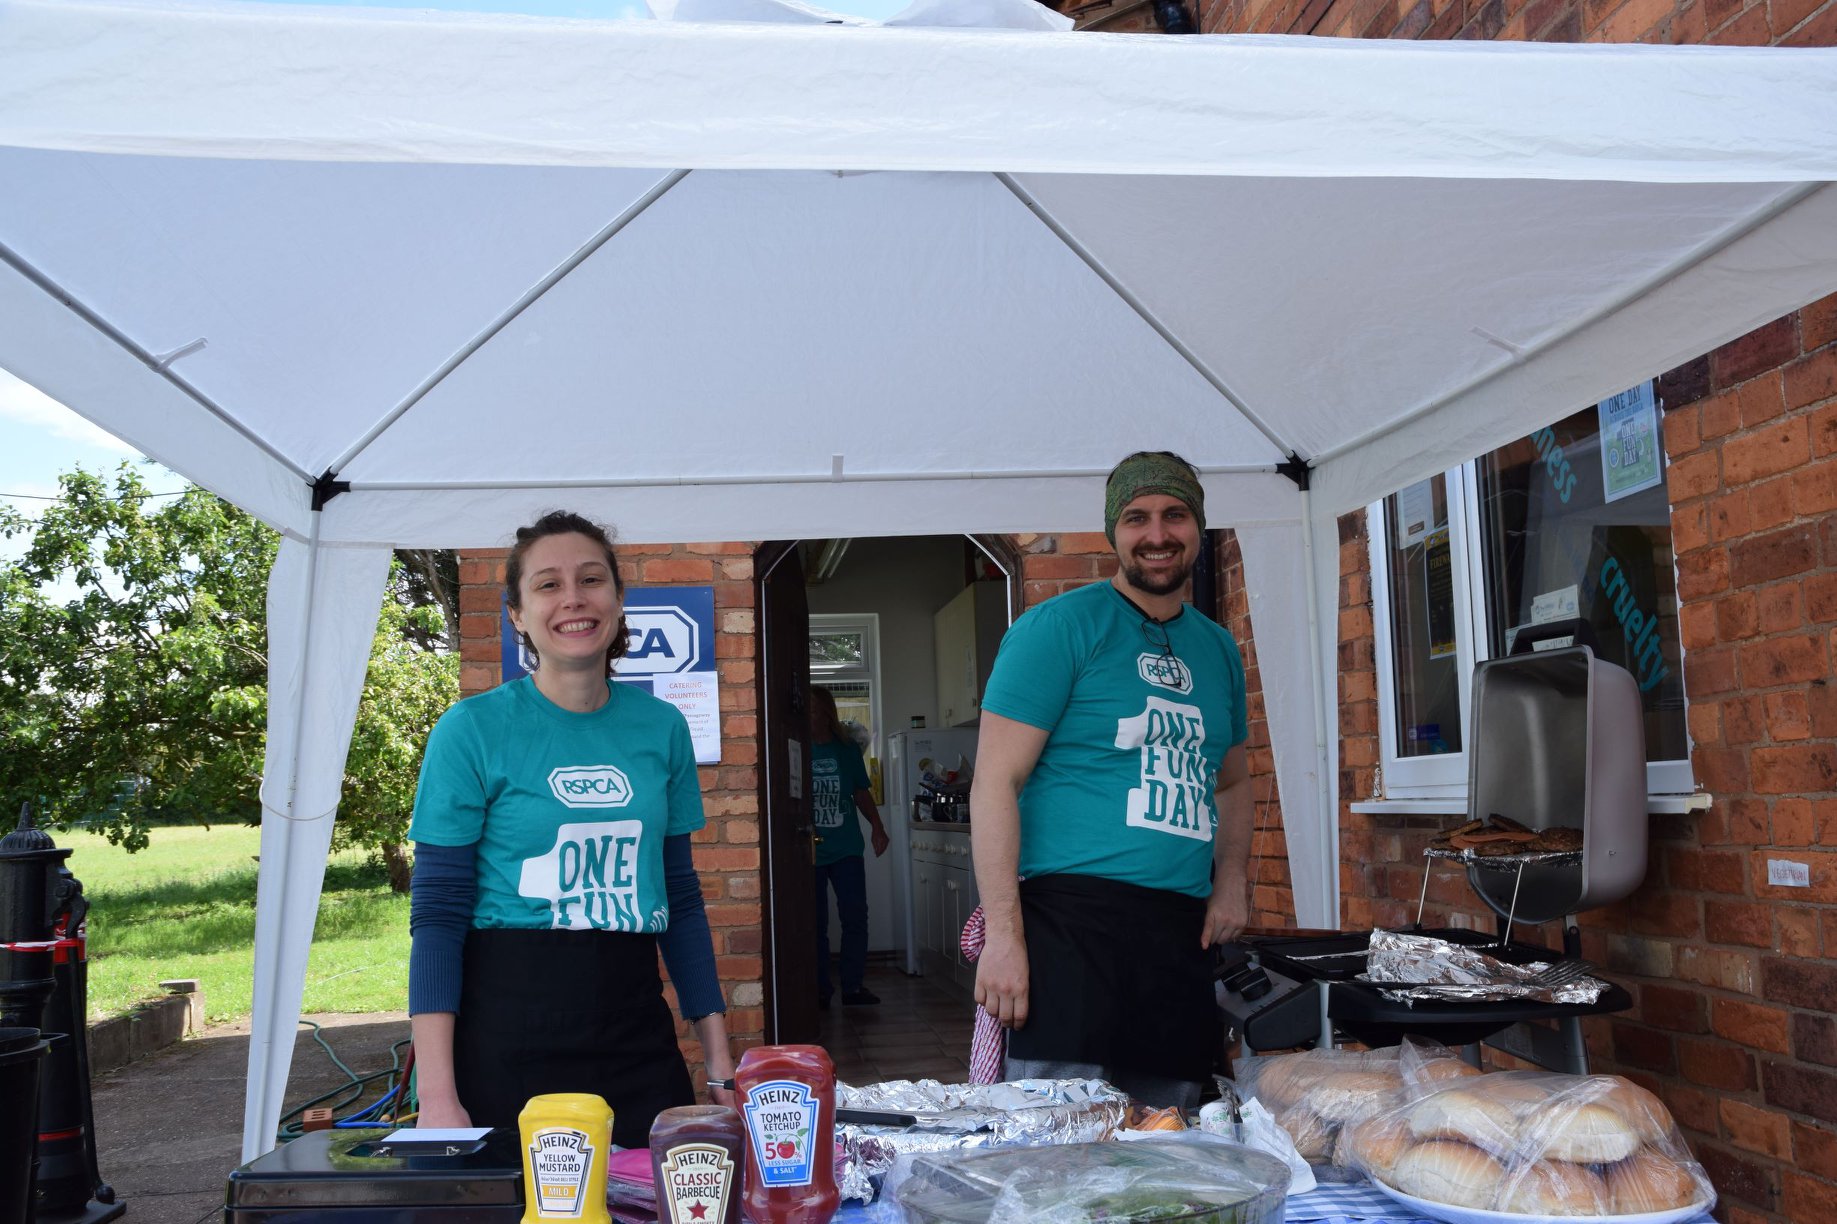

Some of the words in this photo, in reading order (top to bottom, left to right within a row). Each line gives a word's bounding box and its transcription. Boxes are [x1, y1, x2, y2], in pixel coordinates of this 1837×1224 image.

[1600, 556, 1669, 692] cruelty
[1144, 708, 1200, 754] ONE
[1145, 746, 1203, 786] FUN
[561, 777, 622, 795] RSPCA
[1144, 778, 1204, 831] DAY
[559, 835, 637, 893] ONE
[558, 890, 638, 932] FUN
[759, 1090, 800, 1106] HEINZ
[760, 1111, 802, 1123] TOMATO
[764, 1122, 801, 1131] KETCHUP
[543, 1136, 578, 1149] HEINZ
[544, 1154, 576, 1162] YELLOW
[678, 1153, 718, 1167] HEINZ
[540, 1163, 581, 1172] MUSTARD
[674, 1172, 722, 1186] CLASSIC
[548, 1187, 569, 1196] MILD
[676, 1186, 720, 1200] BARBECUE
